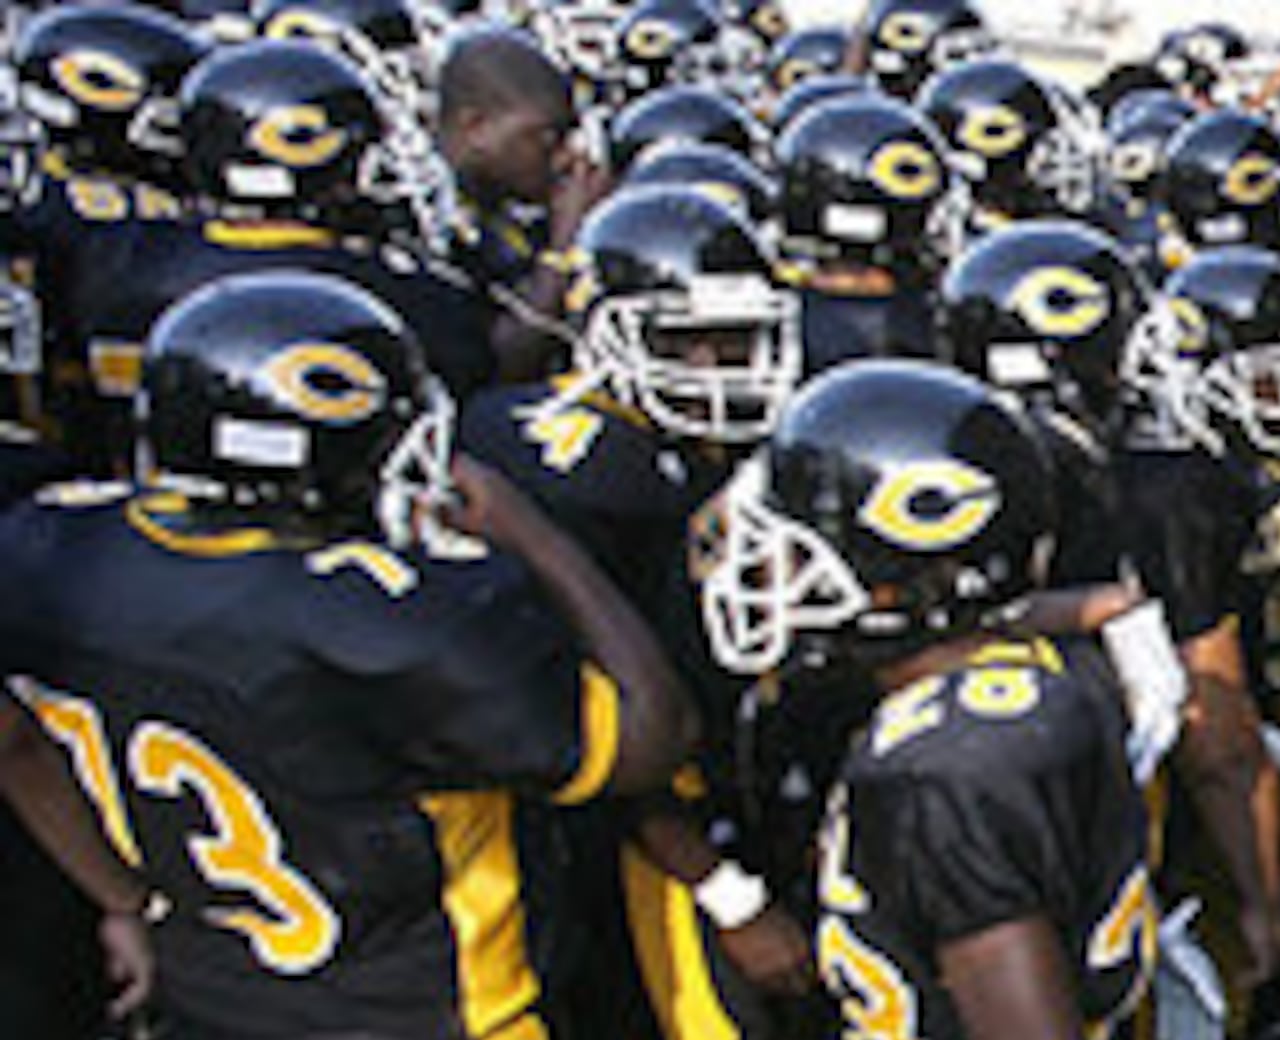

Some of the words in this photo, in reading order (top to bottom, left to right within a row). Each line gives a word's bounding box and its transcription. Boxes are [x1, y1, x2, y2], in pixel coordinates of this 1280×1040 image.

[50, 49, 145, 108] C
[248, 104, 347, 166] C
[957, 105, 1027, 153] C
[867, 142, 938, 197] C
[1221, 154, 1280, 204] C
[1010, 265, 1108, 336] C
[258, 343, 387, 423] C
[858, 456, 1002, 550] C
[5, 674, 342, 975] 73
